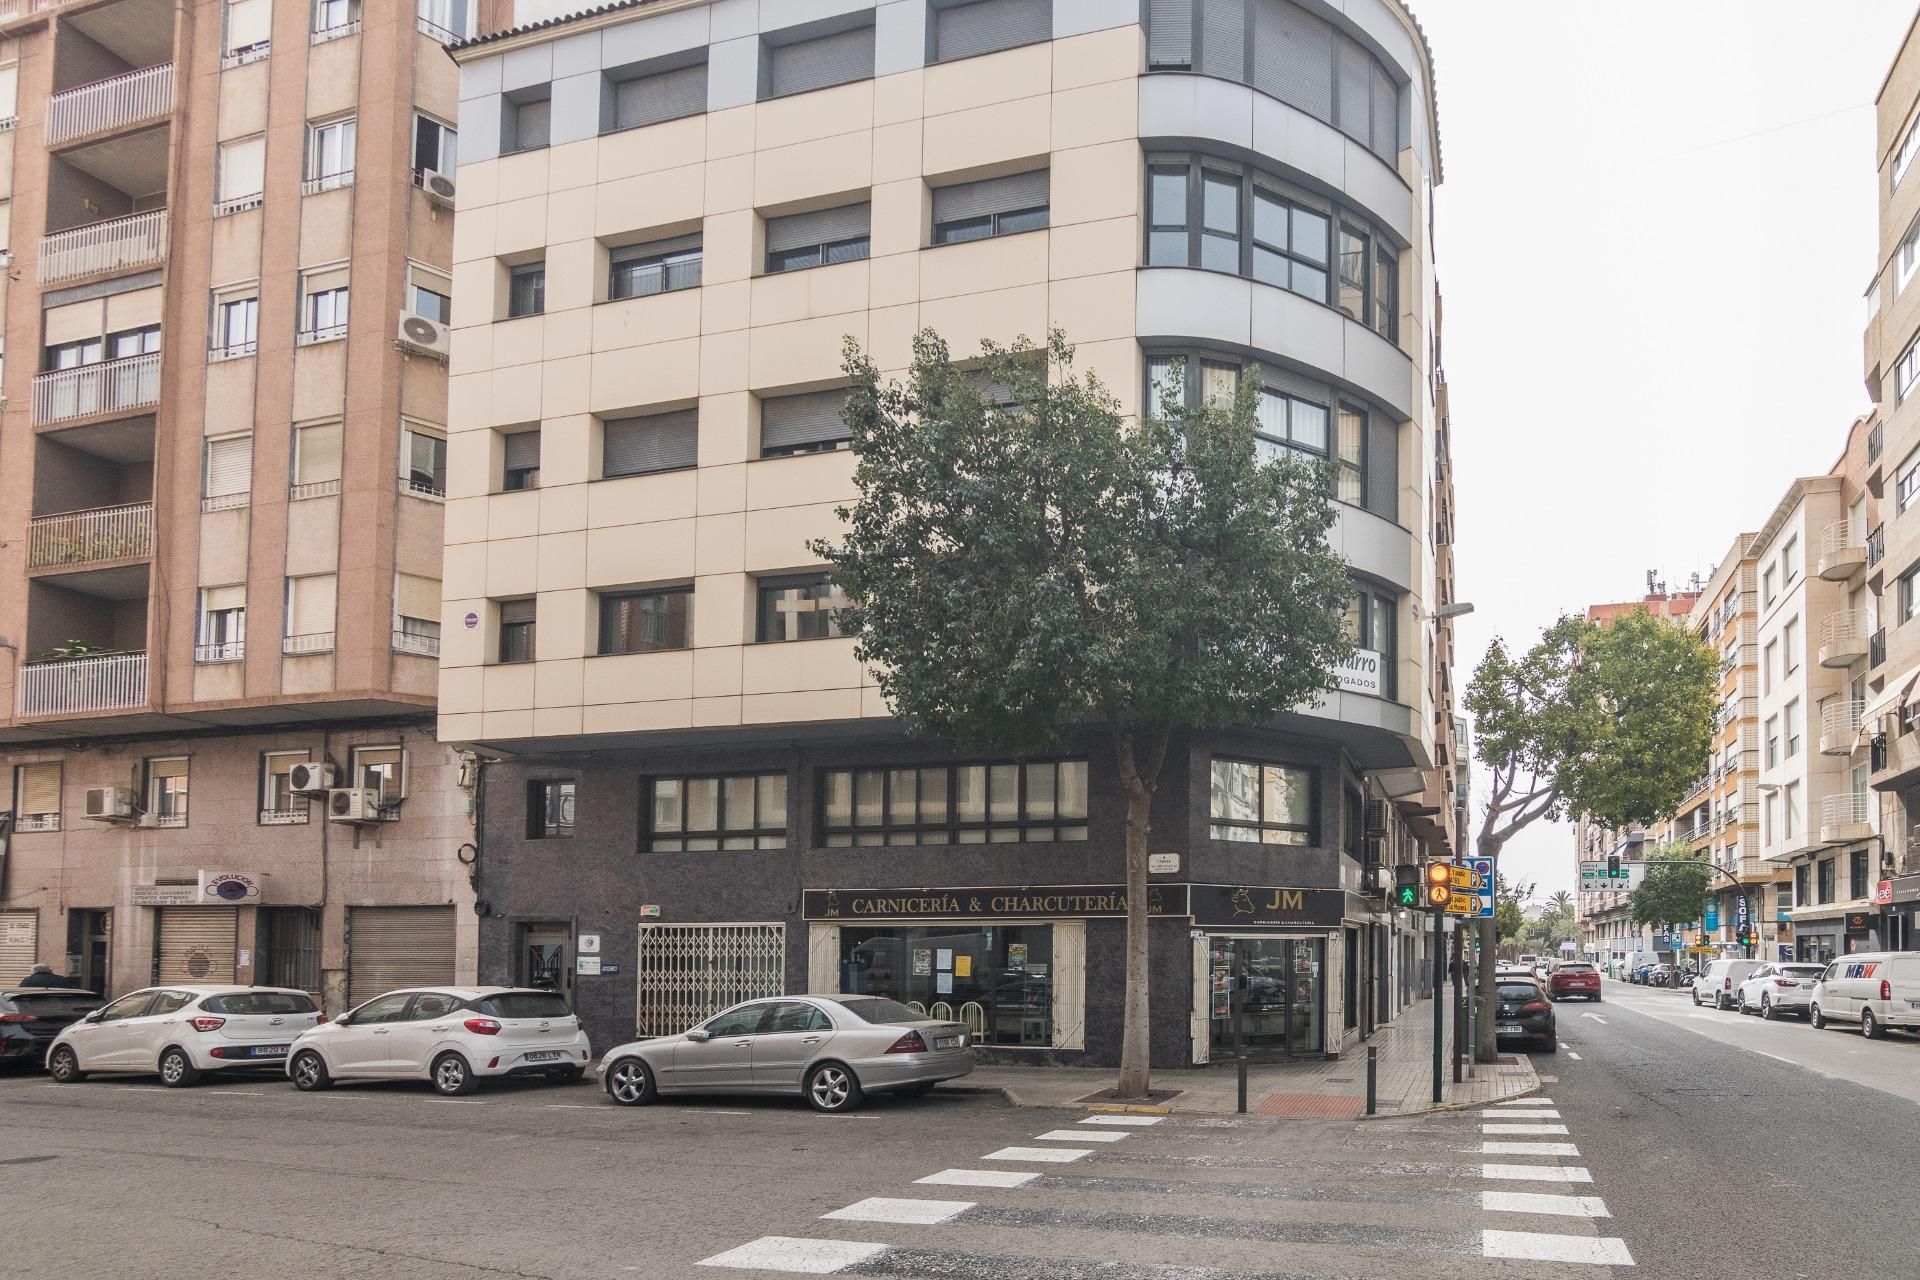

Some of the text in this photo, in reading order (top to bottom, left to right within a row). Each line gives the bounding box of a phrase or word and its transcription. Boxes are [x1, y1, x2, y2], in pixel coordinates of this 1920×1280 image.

[852, 892, 1128, 914] CARNICERÍA & CHARCUTERÍA
[1266, 889, 1303, 910] JM
[824, 908, 839, 917] JM
[1845, 964, 1877, 978] MRW
